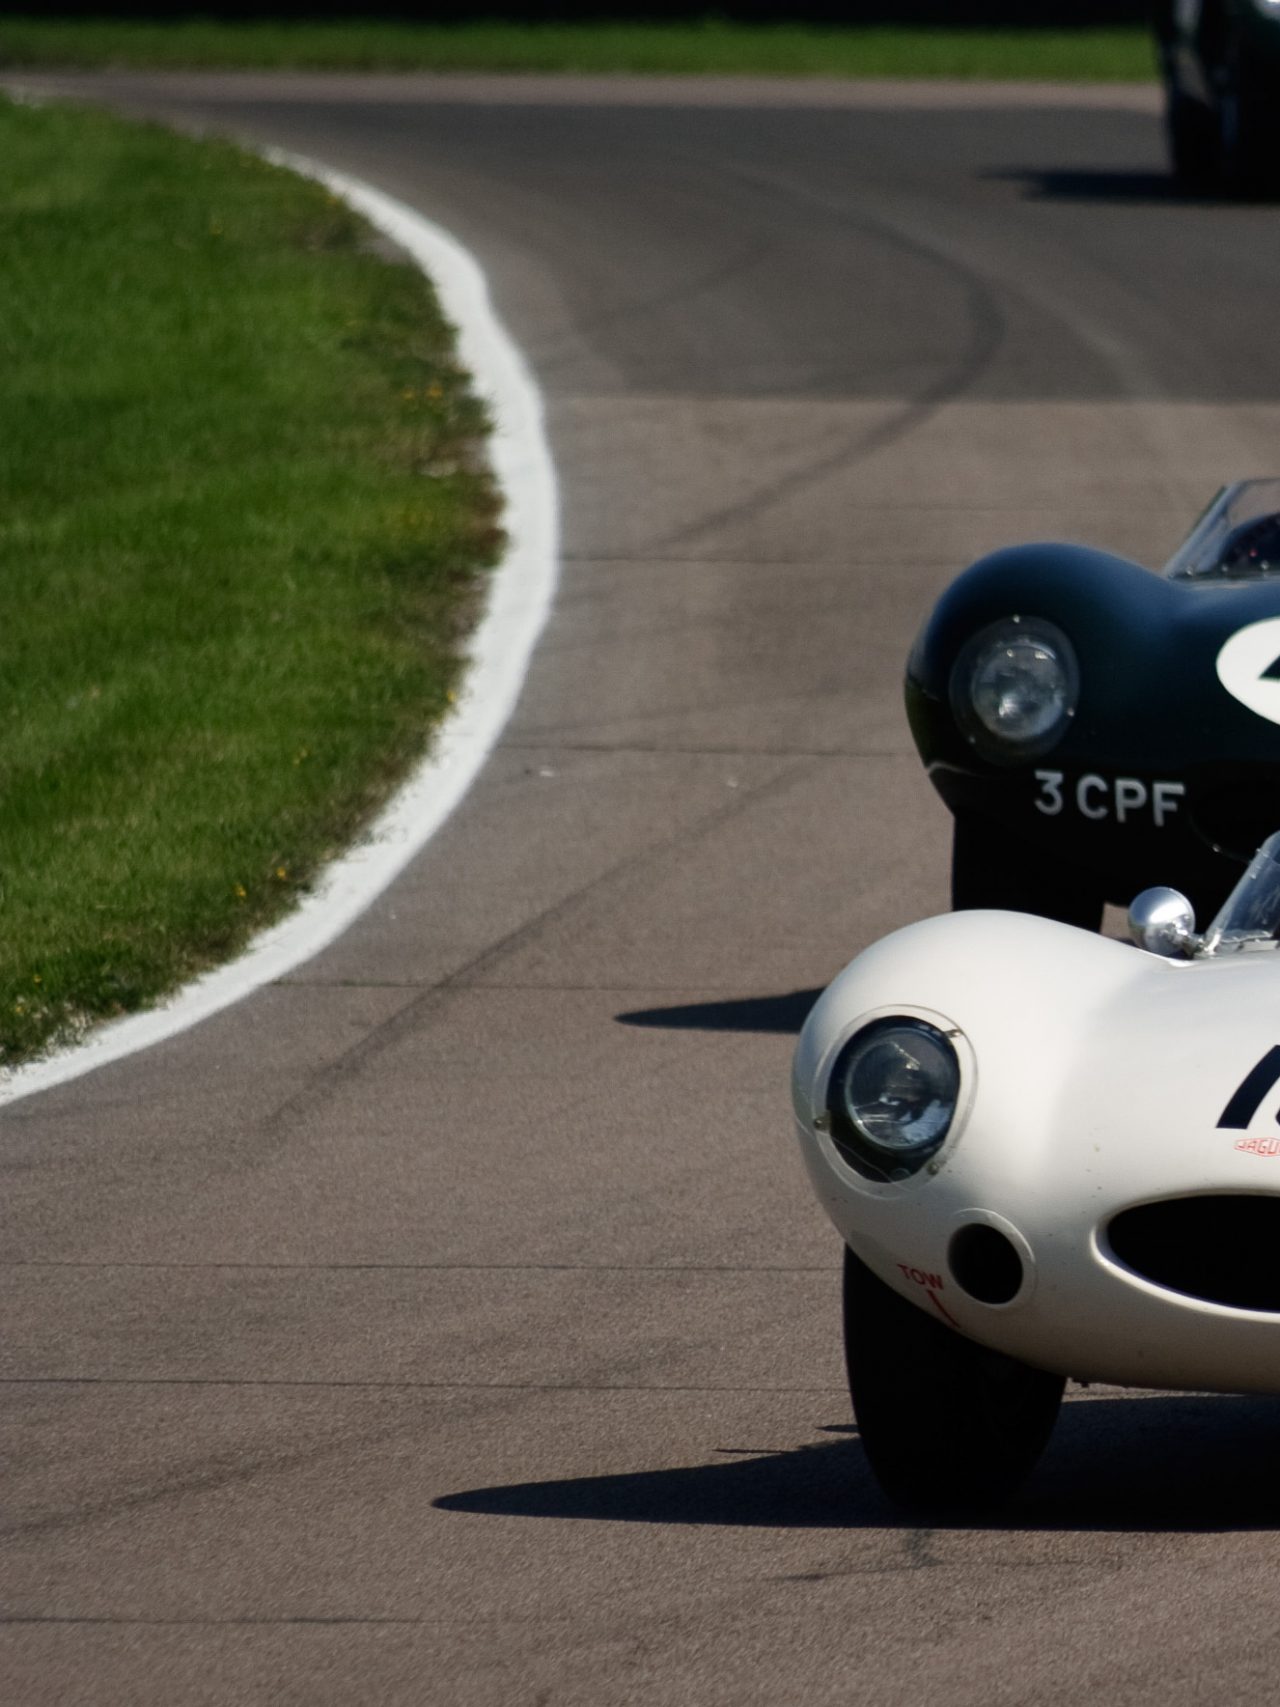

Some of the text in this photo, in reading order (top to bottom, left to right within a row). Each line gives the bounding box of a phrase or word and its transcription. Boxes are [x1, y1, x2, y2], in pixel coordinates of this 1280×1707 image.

[1034, 769, 1185, 827] 3 CPF
[897, 1263, 944, 1290] TOW
